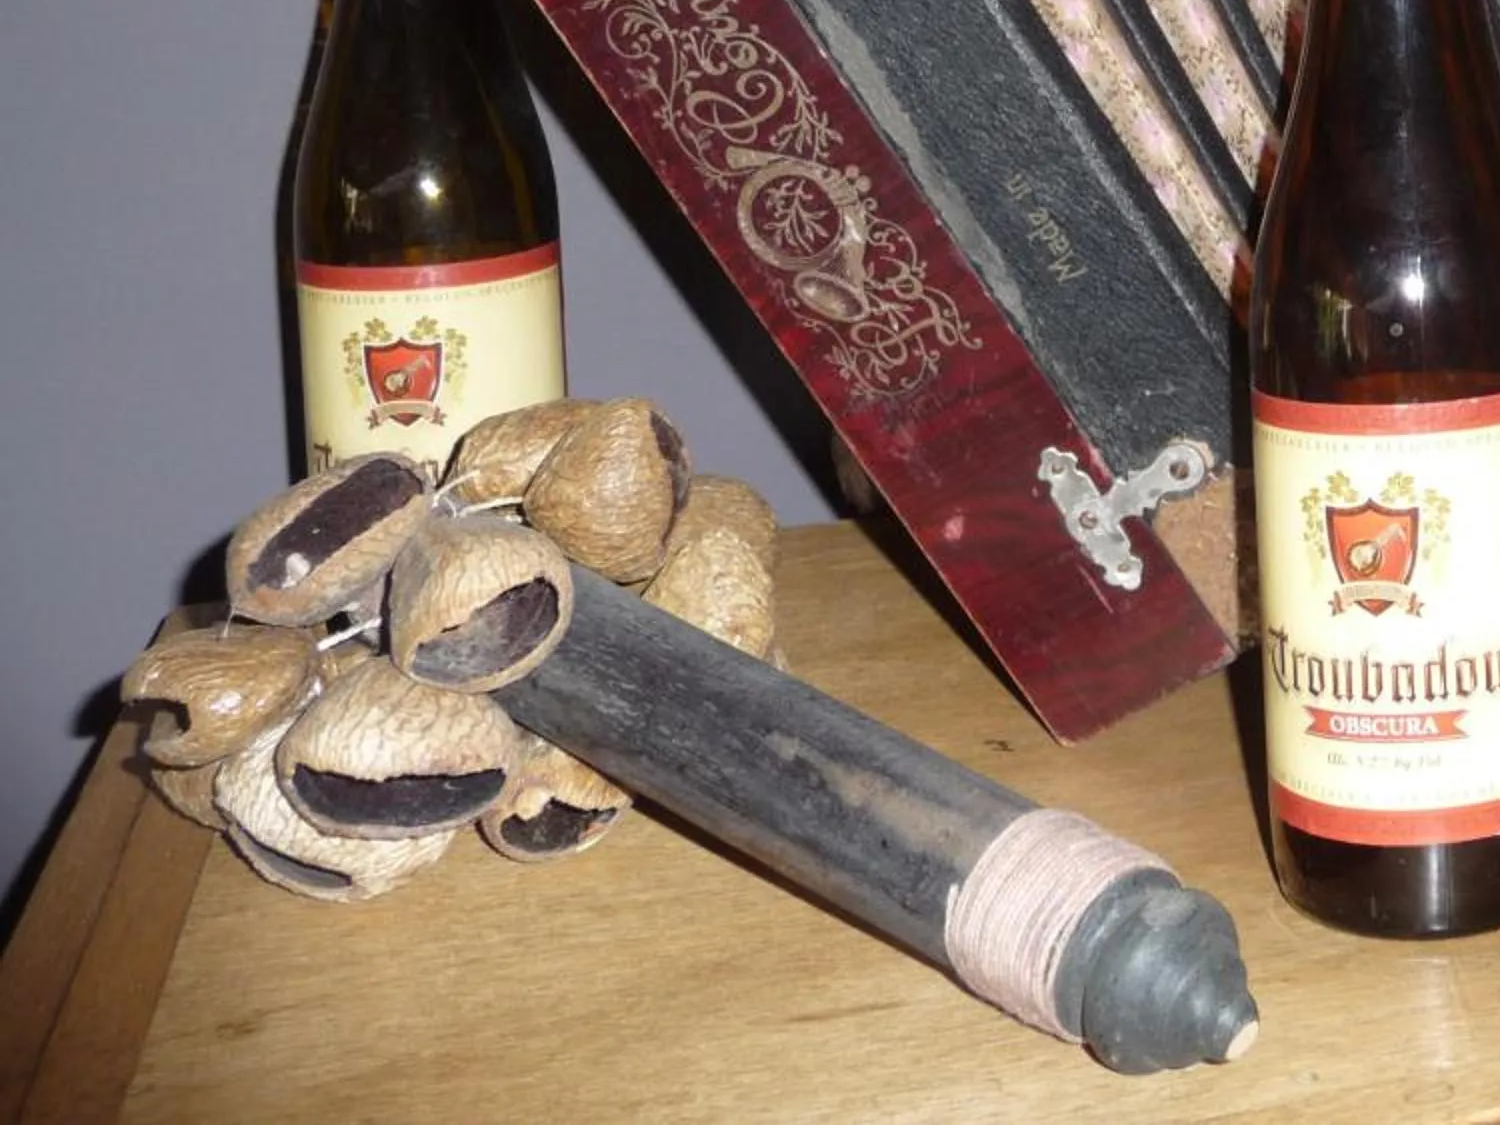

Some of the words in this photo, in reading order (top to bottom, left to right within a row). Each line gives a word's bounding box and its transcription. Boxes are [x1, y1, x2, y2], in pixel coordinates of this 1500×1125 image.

[1007, 172, 1031, 203] in
[1026, 206, 1090, 285] Made
[1329, 715, 1440, 736] OBSCURA
